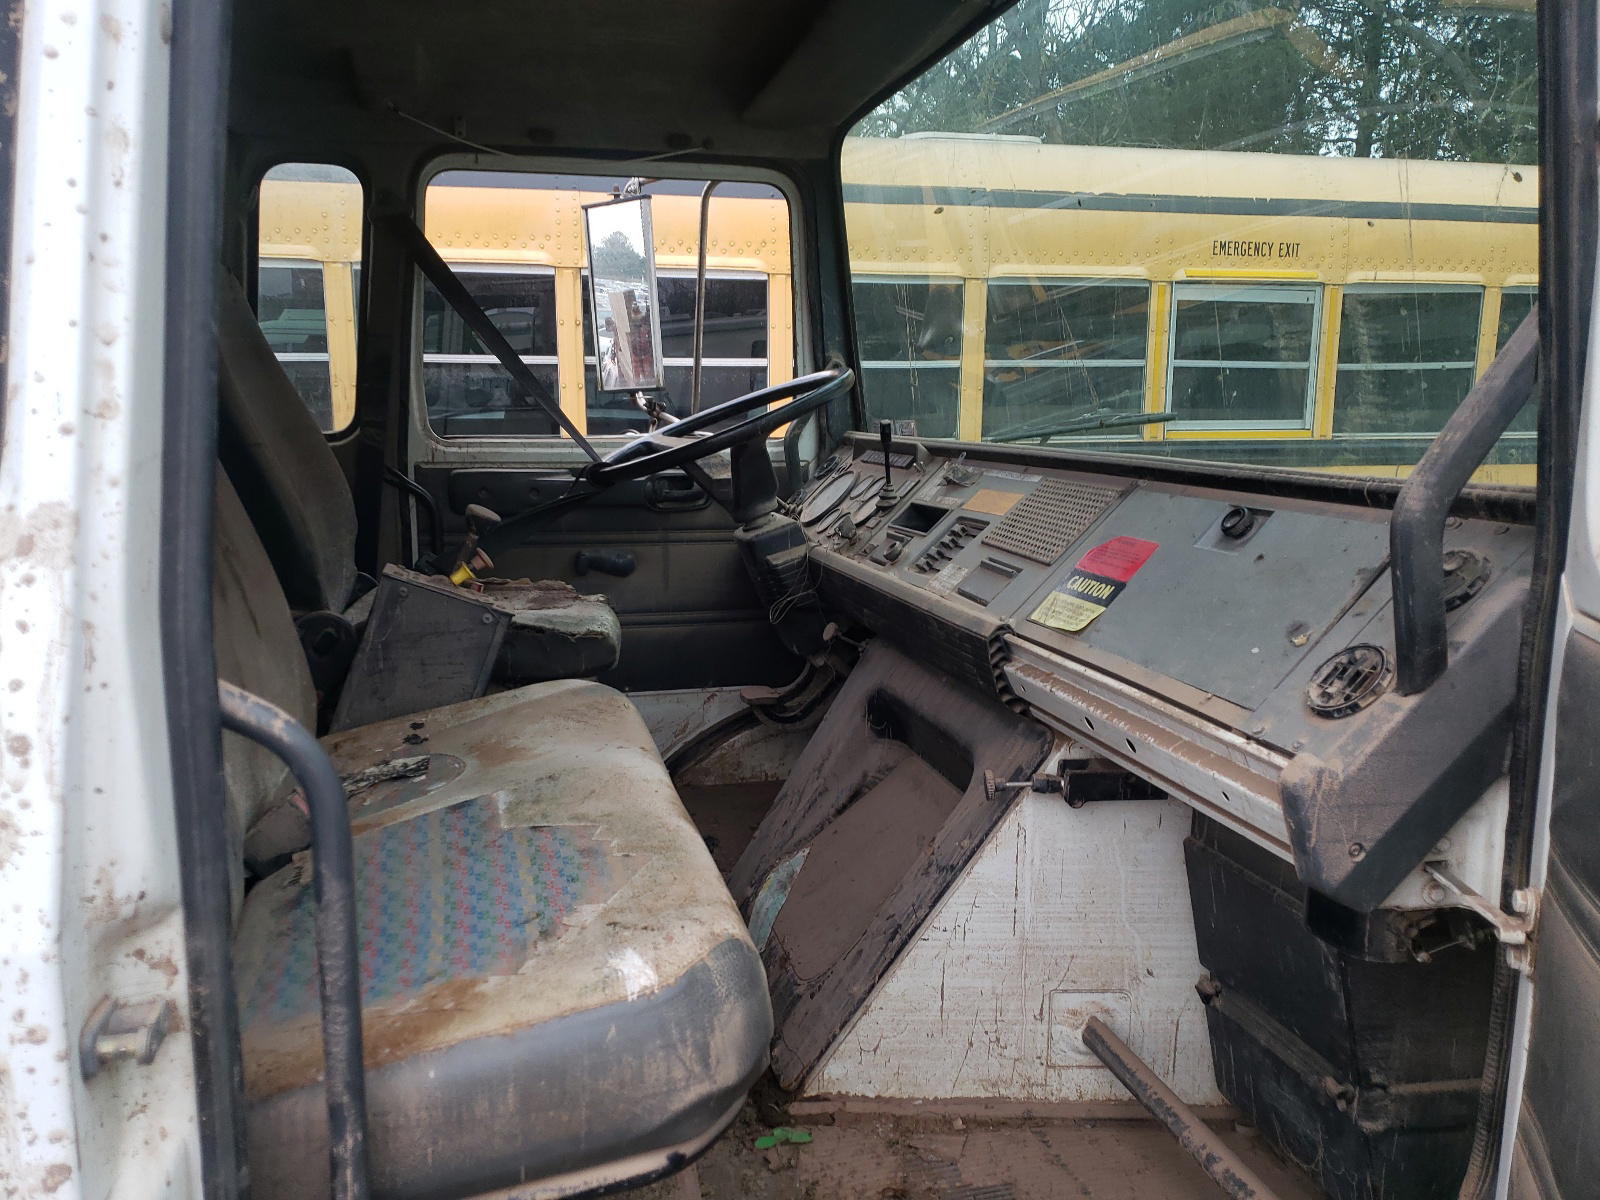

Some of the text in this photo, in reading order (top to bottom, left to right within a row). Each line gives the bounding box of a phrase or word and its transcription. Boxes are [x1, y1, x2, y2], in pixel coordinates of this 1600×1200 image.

[1212, 240, 1301, 258] EMERGENCY EXIT
[1066, 575, 1116, 600] CAUTION
